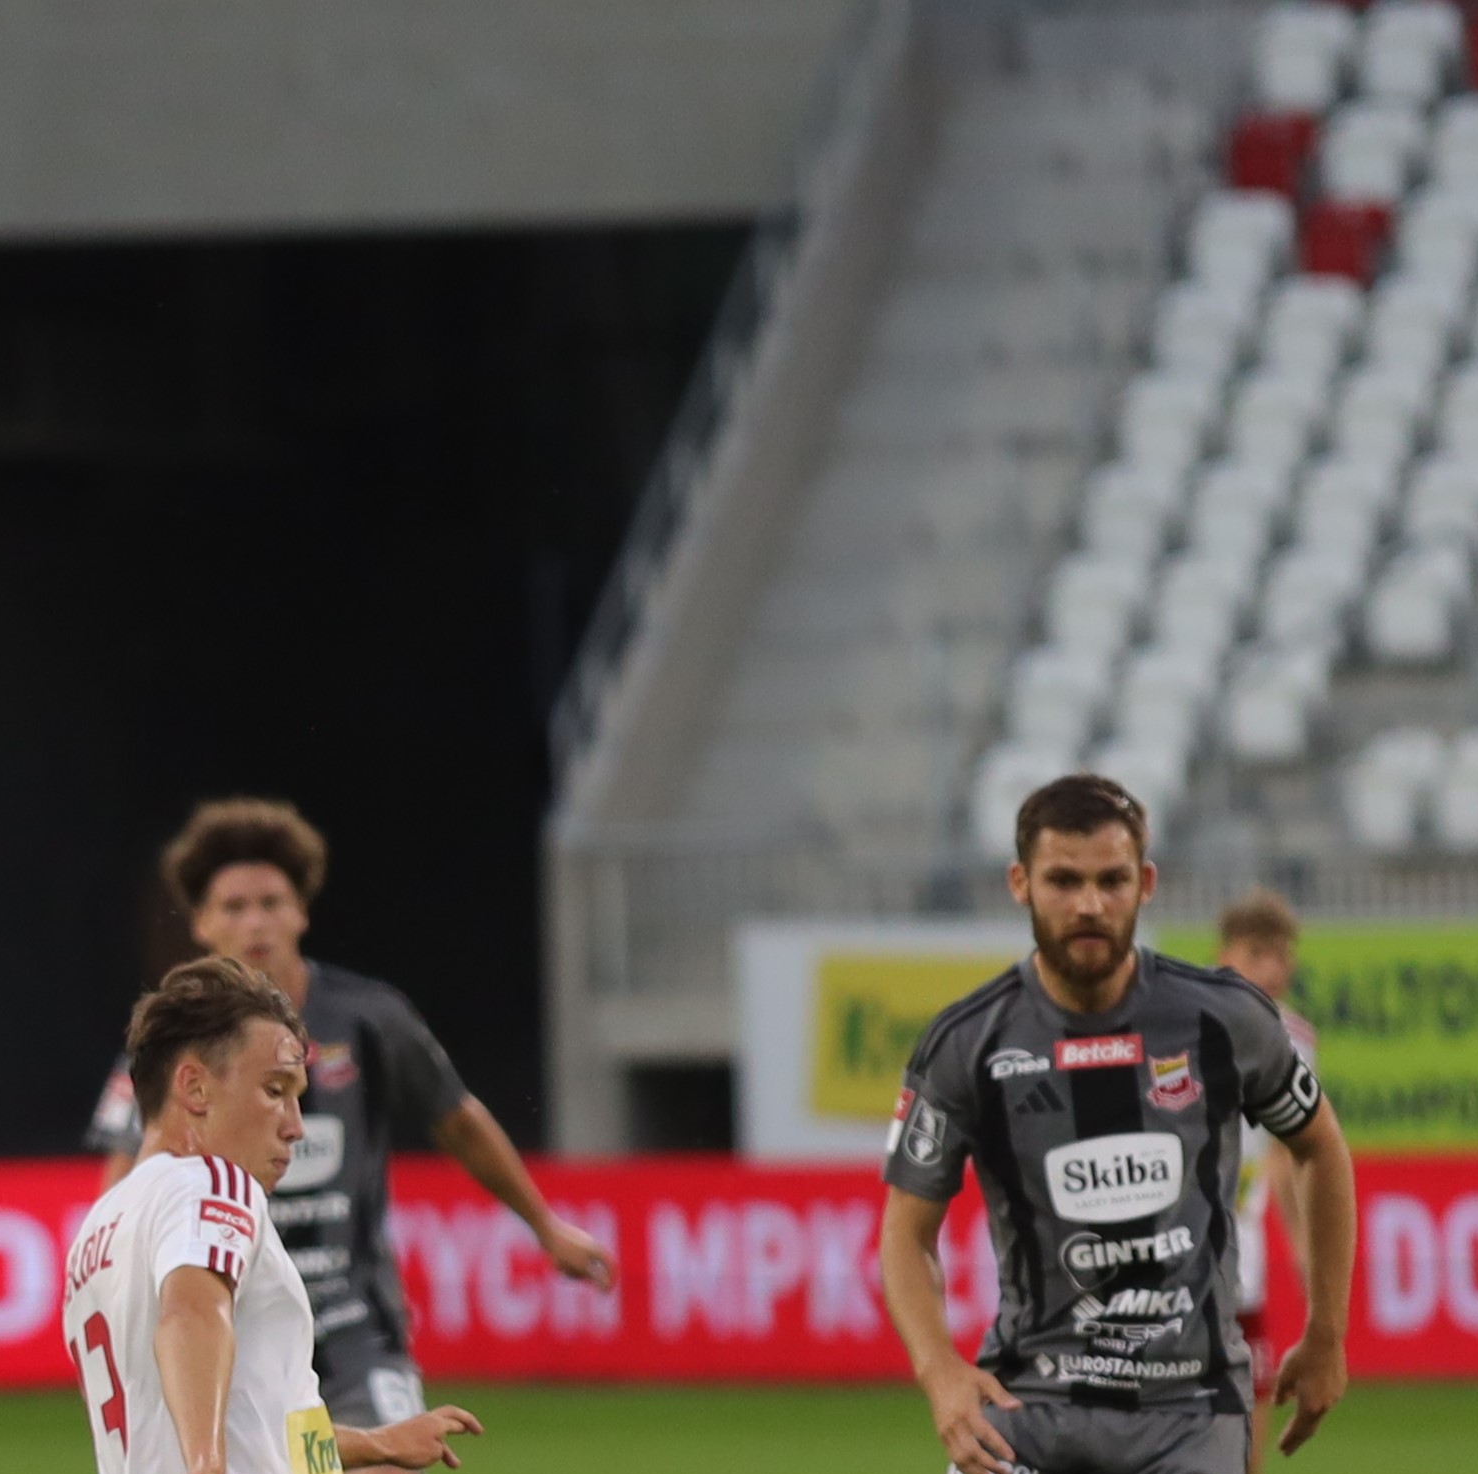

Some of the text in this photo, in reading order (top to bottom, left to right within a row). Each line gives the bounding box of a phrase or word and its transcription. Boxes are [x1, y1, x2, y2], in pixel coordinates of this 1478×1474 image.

[1062, 1041, 1137, 1065] Betclic
[991, 1056, 1051, 1080] Enea
[1063, 1154, 1172, 1194] Skiba
[1070, 1226, 1195, 1270] GINTER
[1058, 1353, 1203, 1379] EUROSTANDARD
